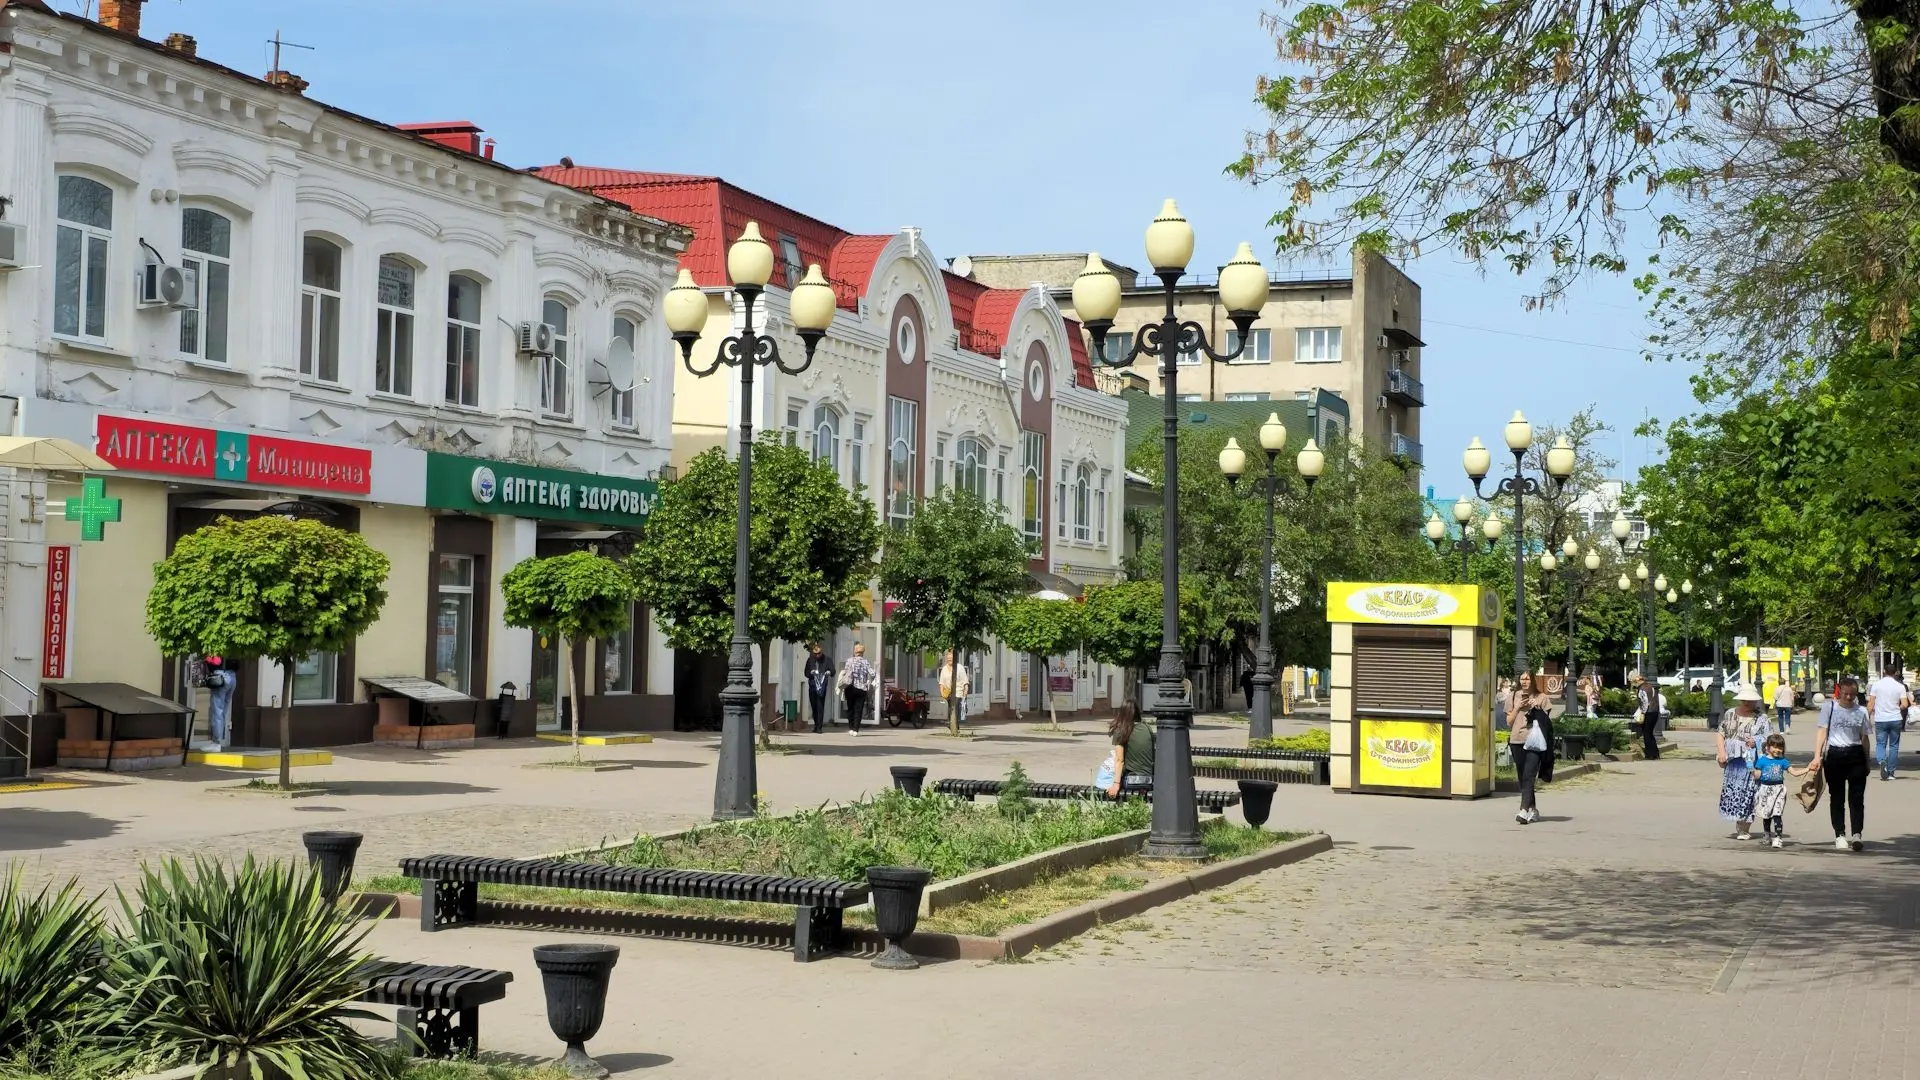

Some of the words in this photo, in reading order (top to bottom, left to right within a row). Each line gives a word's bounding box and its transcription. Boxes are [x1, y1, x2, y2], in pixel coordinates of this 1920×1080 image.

[105, 427, 207, 468] АПТЕКА
[258, 446, 364, 485] Миницена
[503, 477, 571, 508] АПТЕКА
[49, 549, 64, 676] СТОМАТОЛОГИЯ
[1383, 589, 1425, 606] КВАС
[1385, 739, 1419, 755] КВАС
